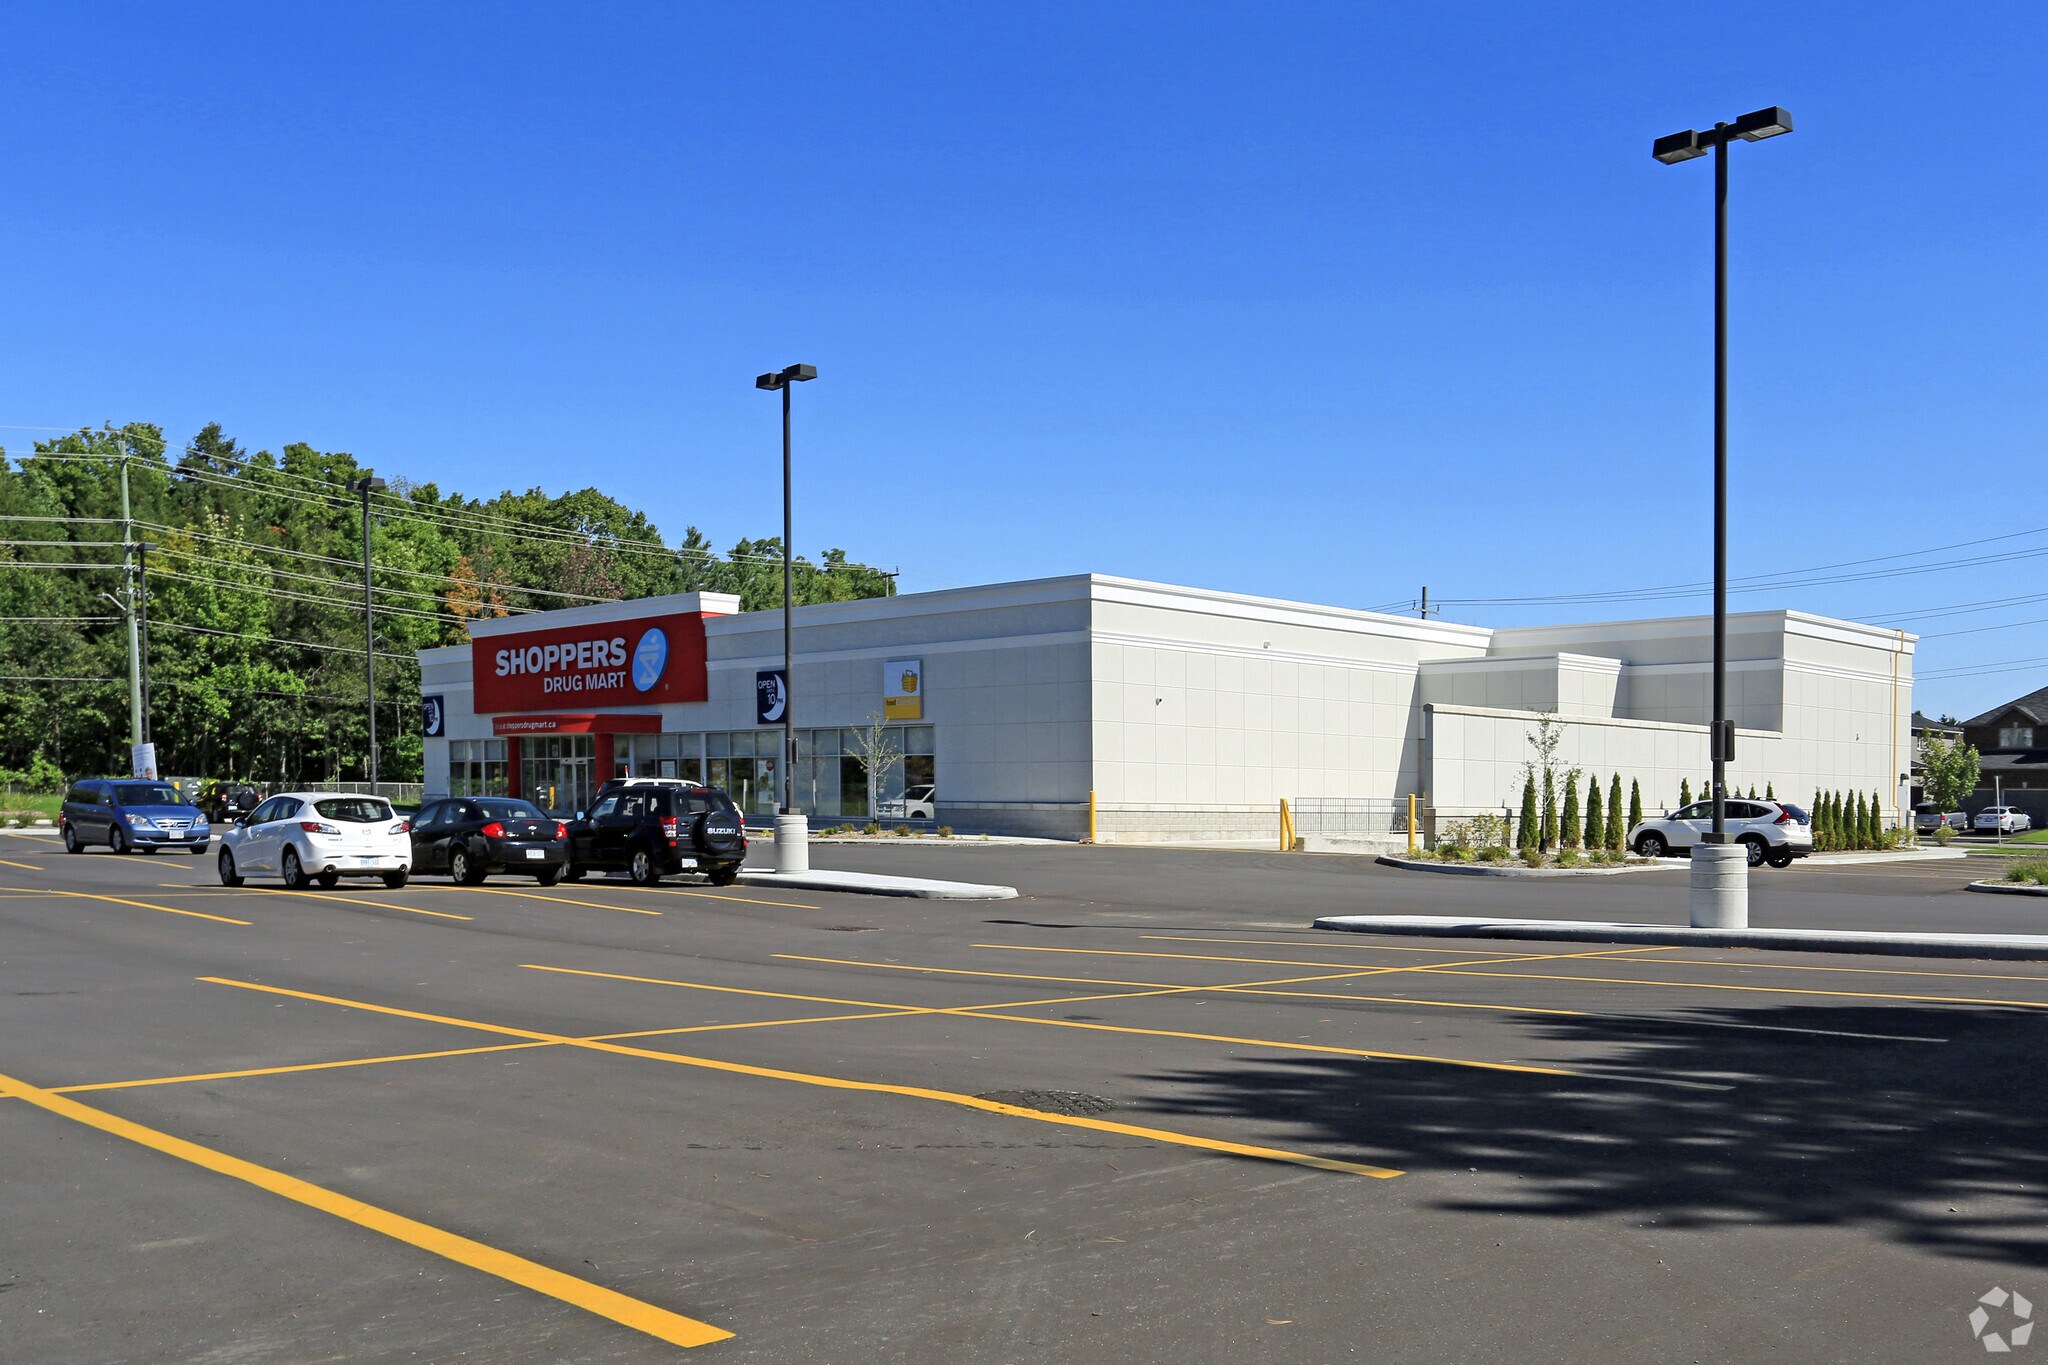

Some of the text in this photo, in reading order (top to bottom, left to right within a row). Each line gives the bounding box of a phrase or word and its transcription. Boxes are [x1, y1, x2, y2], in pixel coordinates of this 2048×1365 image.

[495, 637, 627, 677] SHOPPERS
[543, 671, 627, 693] DRUG MART
[757, 680, 776, 690] OPEN
[767, 693, 776, 705] 10
[707, 827, 736, 835] SUZUKI
